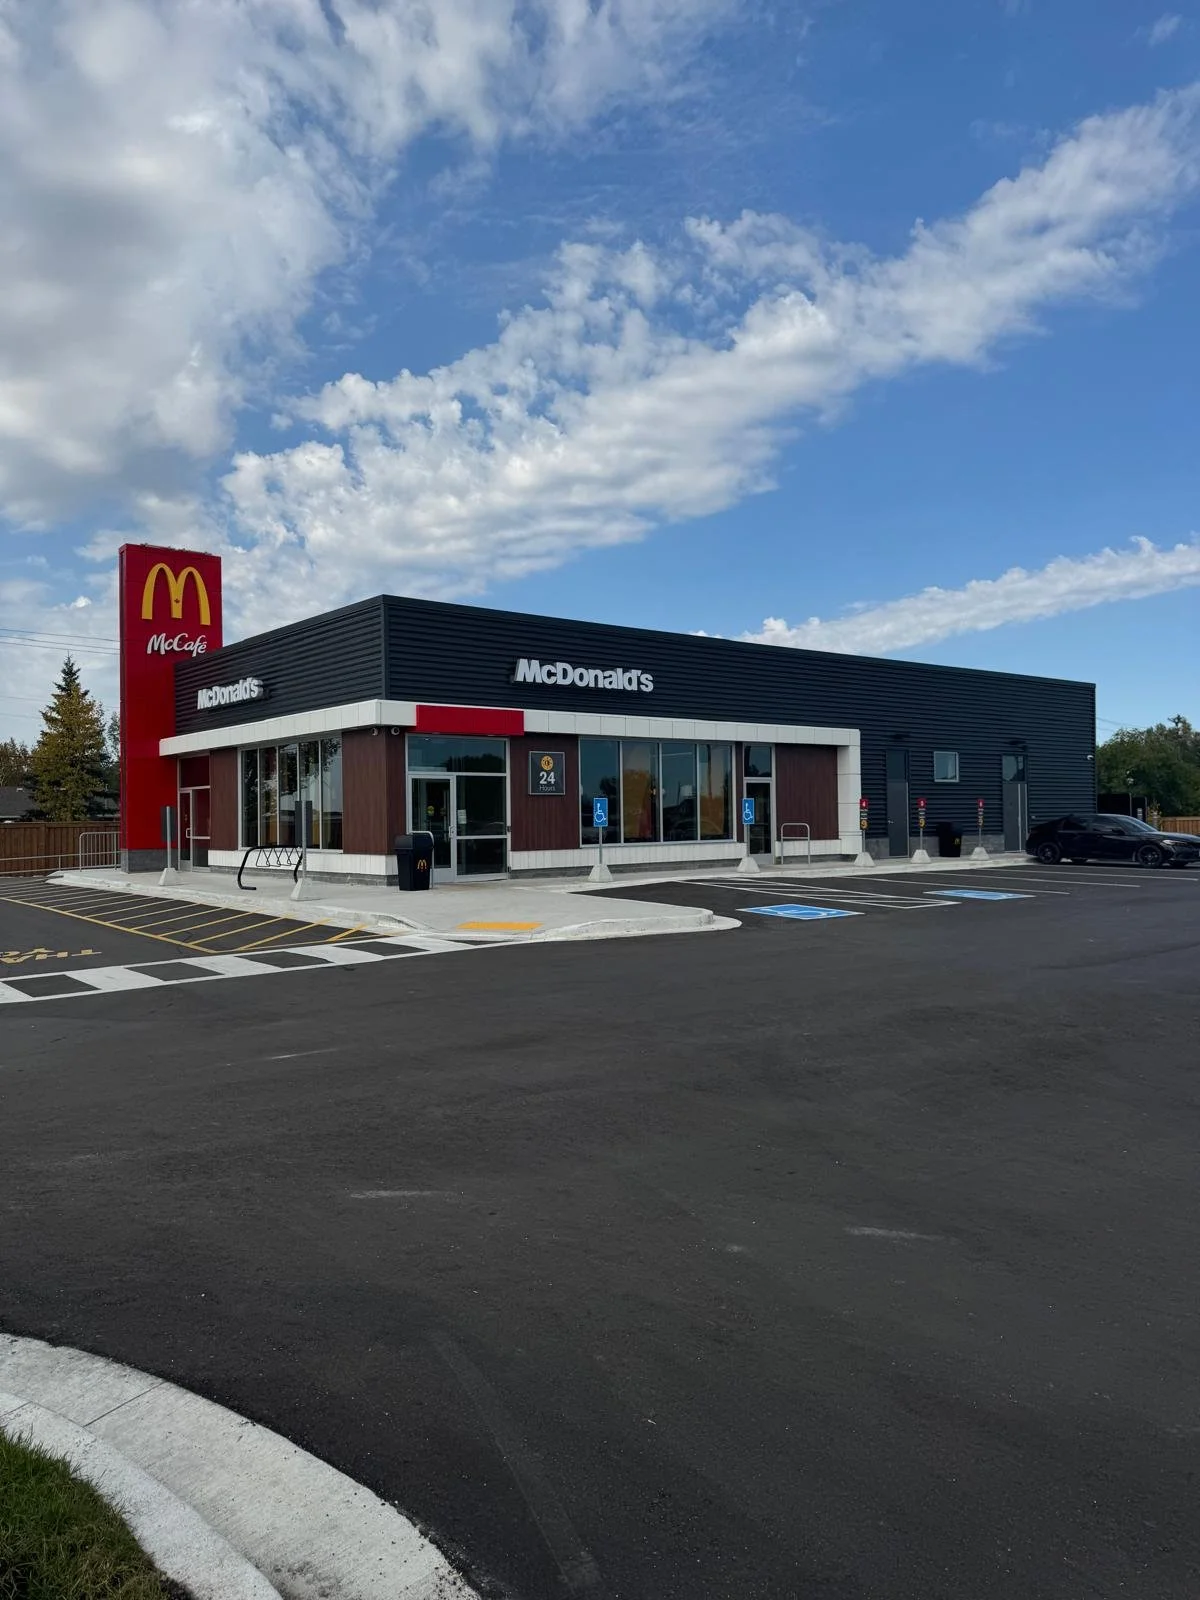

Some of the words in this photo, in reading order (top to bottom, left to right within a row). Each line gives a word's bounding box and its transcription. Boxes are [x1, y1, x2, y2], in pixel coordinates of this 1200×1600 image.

[146, 632, 208, 657] McCafé
[513, 658, 654, 692] McDonald's
[197, 677, 261, 710] McDonald's
[539, 771, 556, 785] 24
